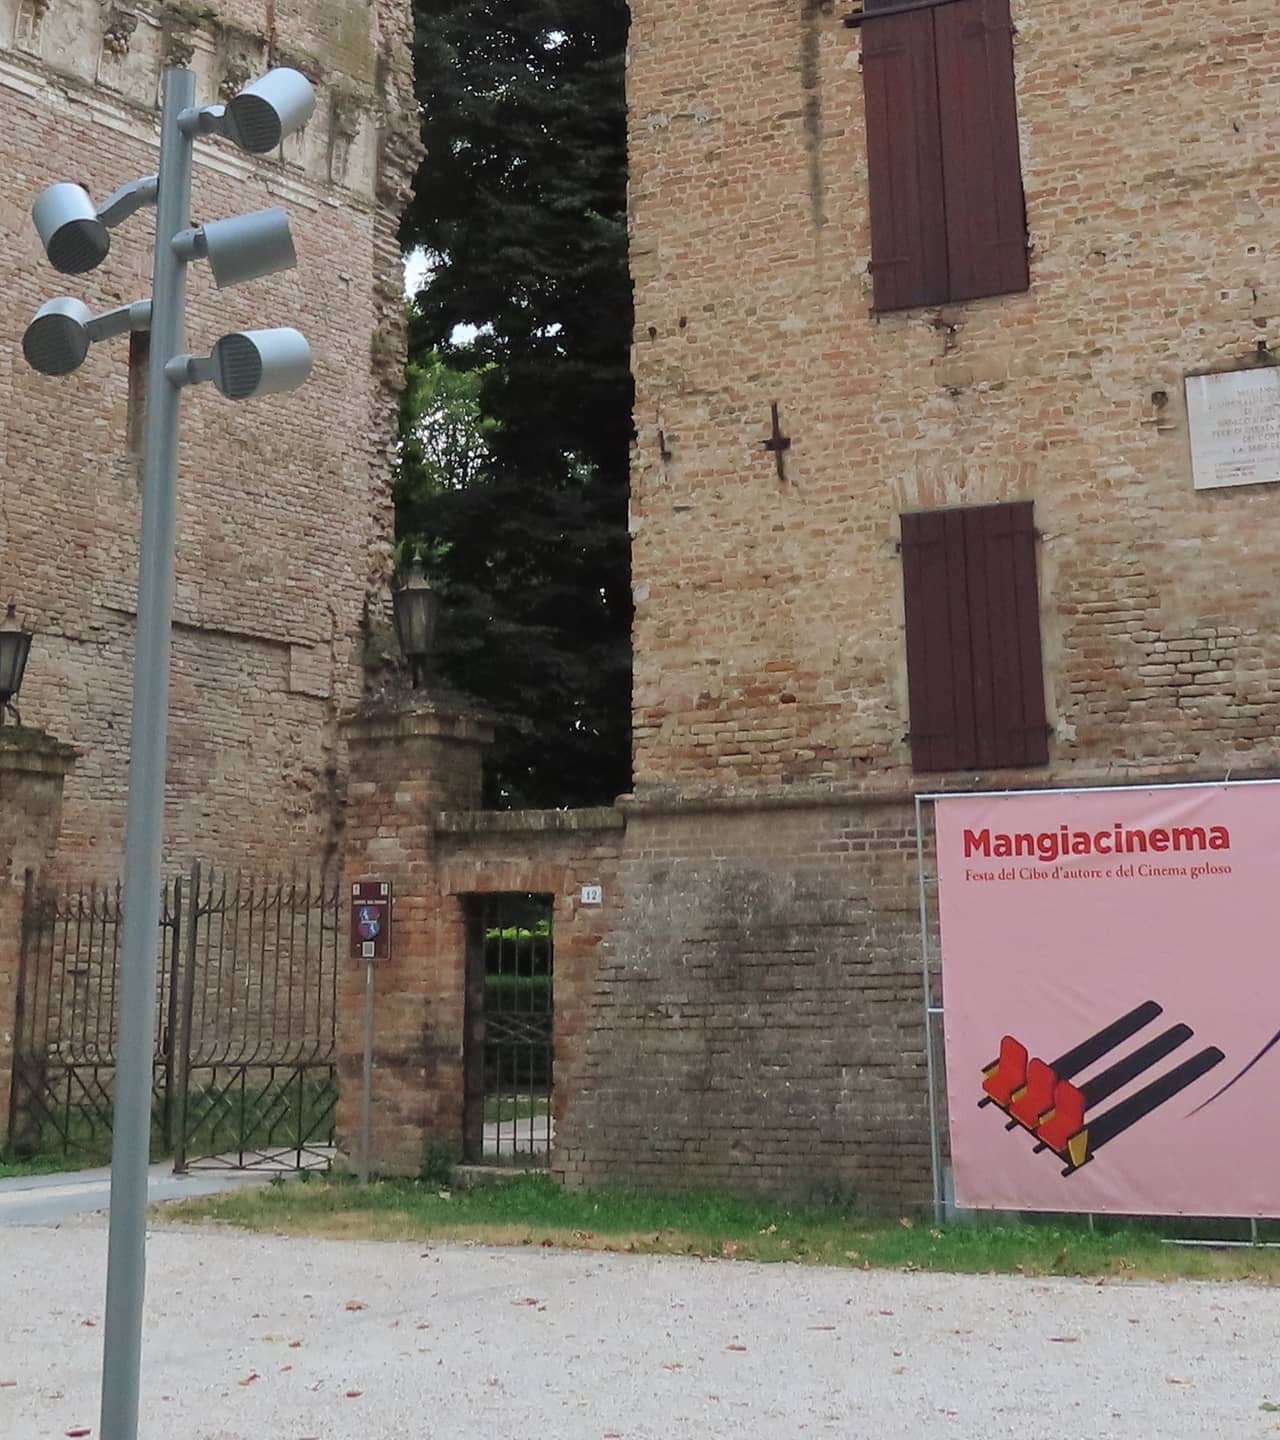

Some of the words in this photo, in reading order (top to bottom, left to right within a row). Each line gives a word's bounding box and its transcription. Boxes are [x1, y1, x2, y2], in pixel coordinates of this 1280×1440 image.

[963, 823, 1231, 862] Mangiacinema
[965, 869, 995, 881] Festa
[998, 867, 1016, 881] del
[1019, 867, 1049, 880] Cibo
[1051, 866, 1103, 880] d'autore
[1106, 870, 1113, 878] e
[1116, 864, 1135, 878] del
[1138, 863, 1187, 877] Cinema
[1191, 862, 1232, 879] goloso
[587, 890, 597, 901] 12
